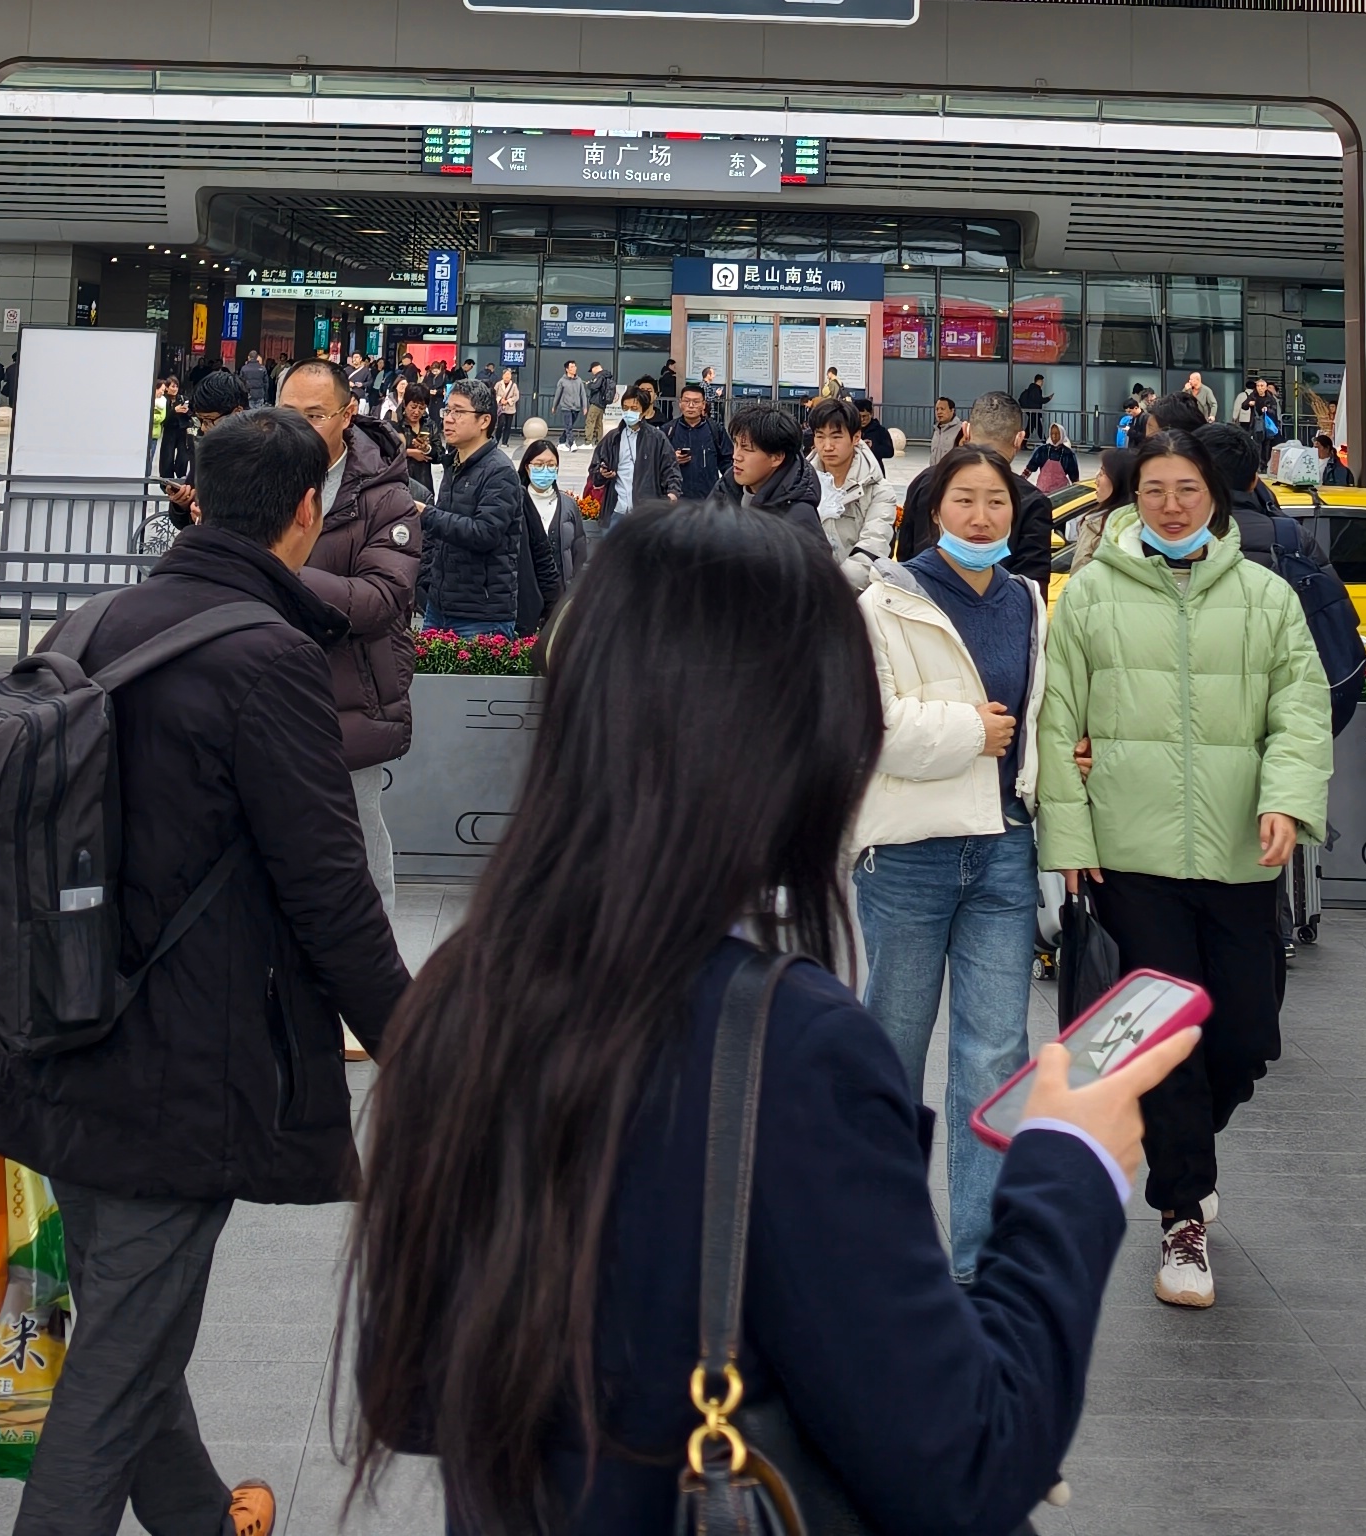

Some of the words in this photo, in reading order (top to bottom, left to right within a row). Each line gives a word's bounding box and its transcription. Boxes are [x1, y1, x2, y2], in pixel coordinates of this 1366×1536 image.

[510, 147, 527, 163] 西
[583, 143, 672, 167] 南广场
[730, 153, 746, 169] 东
[582, 168, 620, 181] South
[624, 169, 671, 183] Square
[729, 169, 746, 178] East
[261, 269, 287, 278] 北广场
[306, 271, 337, 279] 北进站口
[744, 265, 823, 284] 昆山南站
[504, 352, 524, 362] 进站
